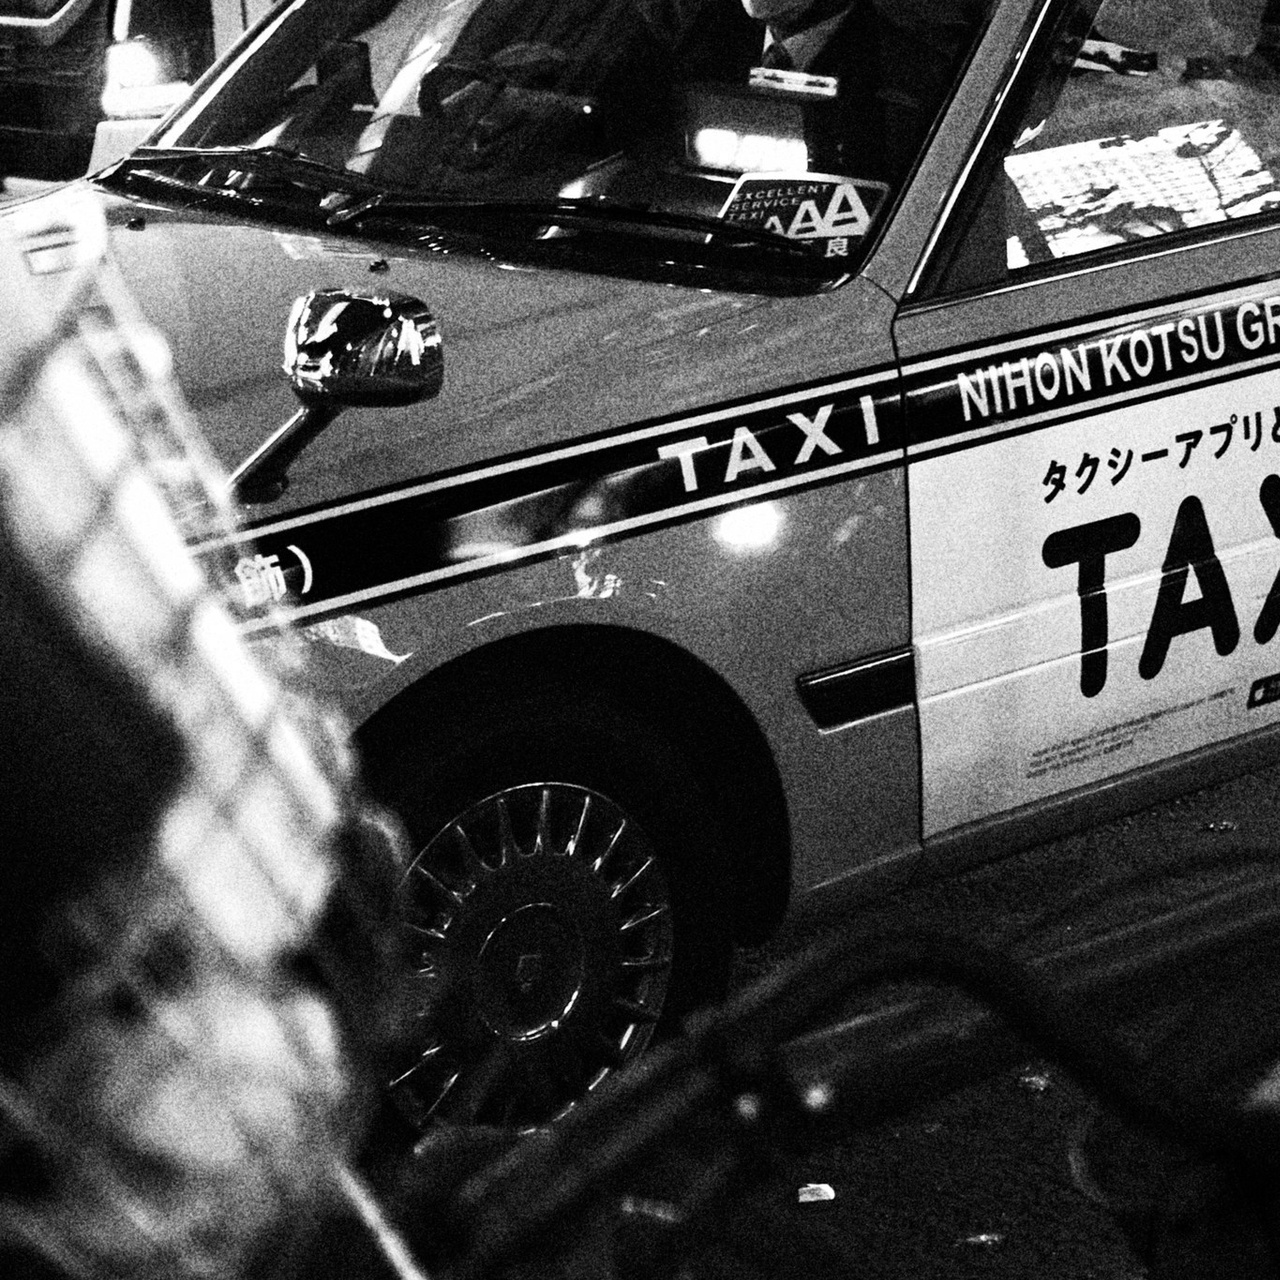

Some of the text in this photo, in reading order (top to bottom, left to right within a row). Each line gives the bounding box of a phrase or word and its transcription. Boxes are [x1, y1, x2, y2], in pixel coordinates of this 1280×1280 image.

[733, 183, 831, 202] EXCELLENT
[729, 197, 802, 212] SERVICE
[727, 210, 765, 222] TAXI
[957, 345, 1091, 422] NIHON
[1098, 317, 1226, 385] KOTSU
[657, 394, 881, 494] TAXI
